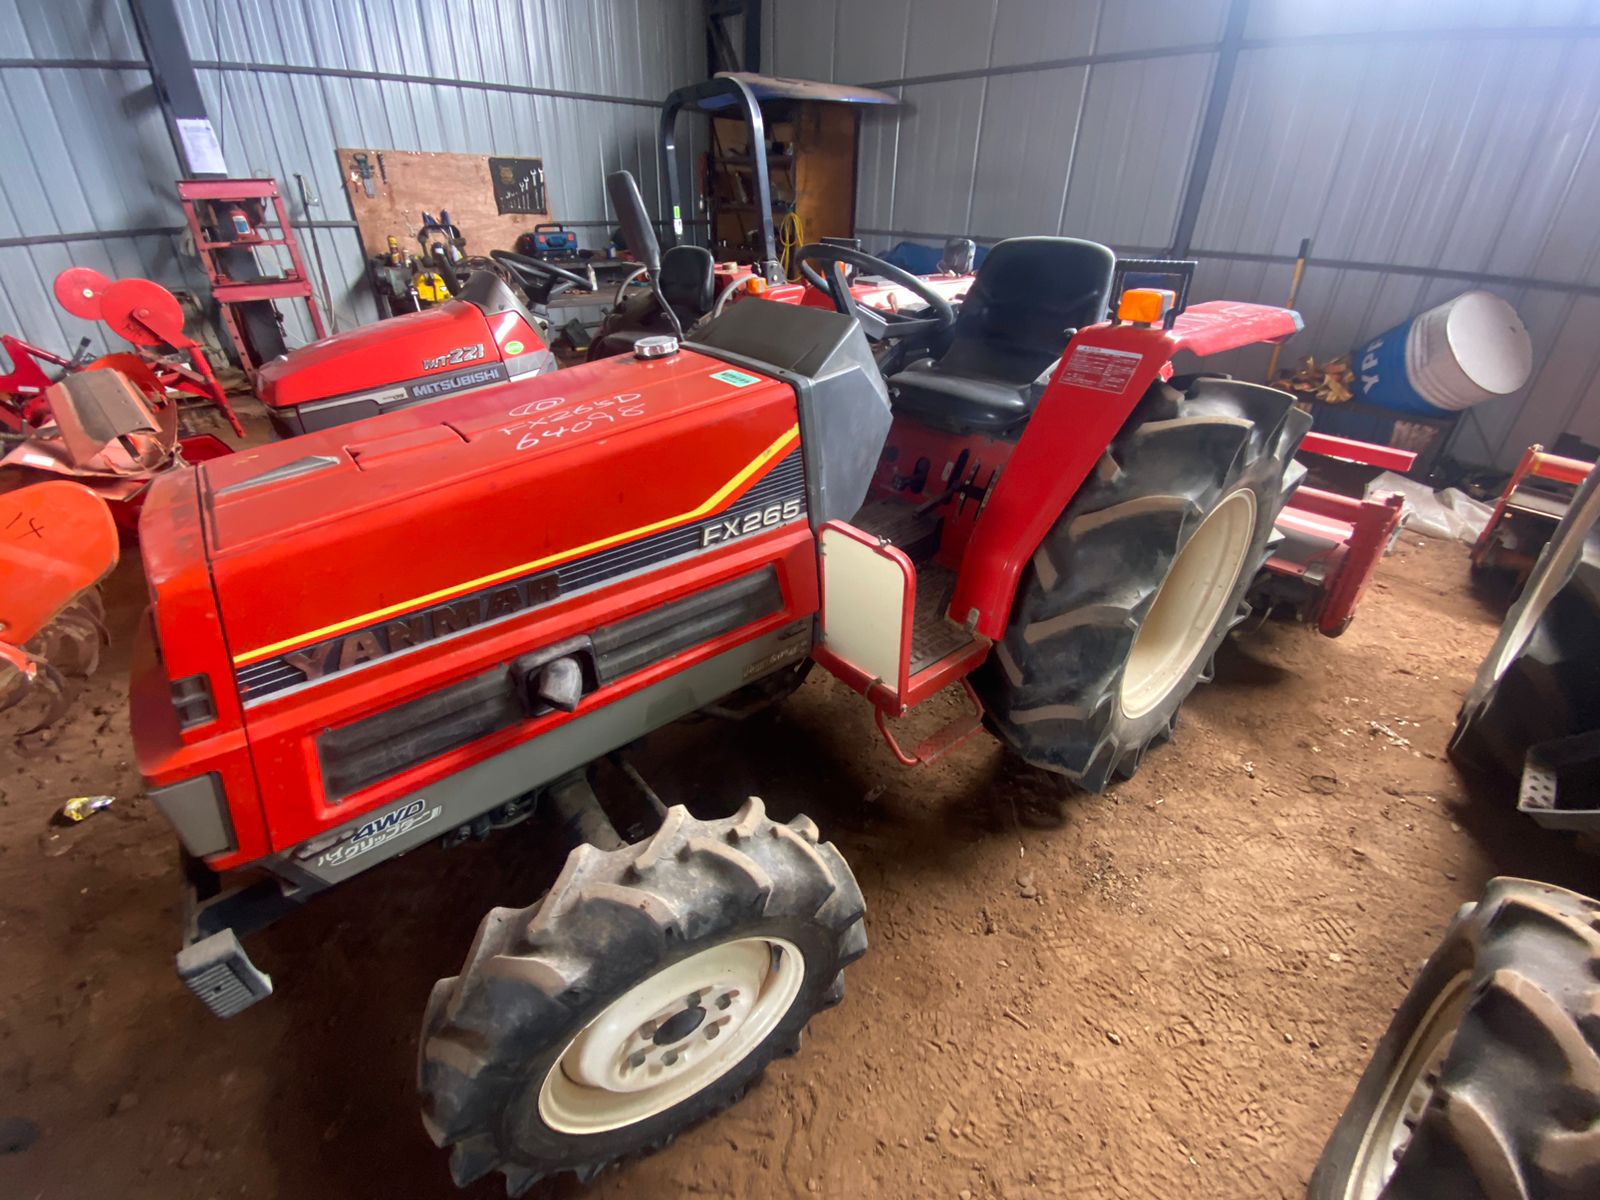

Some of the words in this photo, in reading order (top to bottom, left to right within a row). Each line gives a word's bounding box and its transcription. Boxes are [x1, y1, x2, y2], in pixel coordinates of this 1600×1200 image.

[412, 369, 499, 398] MITSUBISHI
[516, 403, 646, 450] 64098
[703, 499, 801, 547] FX265
[284, 571, 557, 681] YANMAR
[351, 799, 425, 843] 4WD
